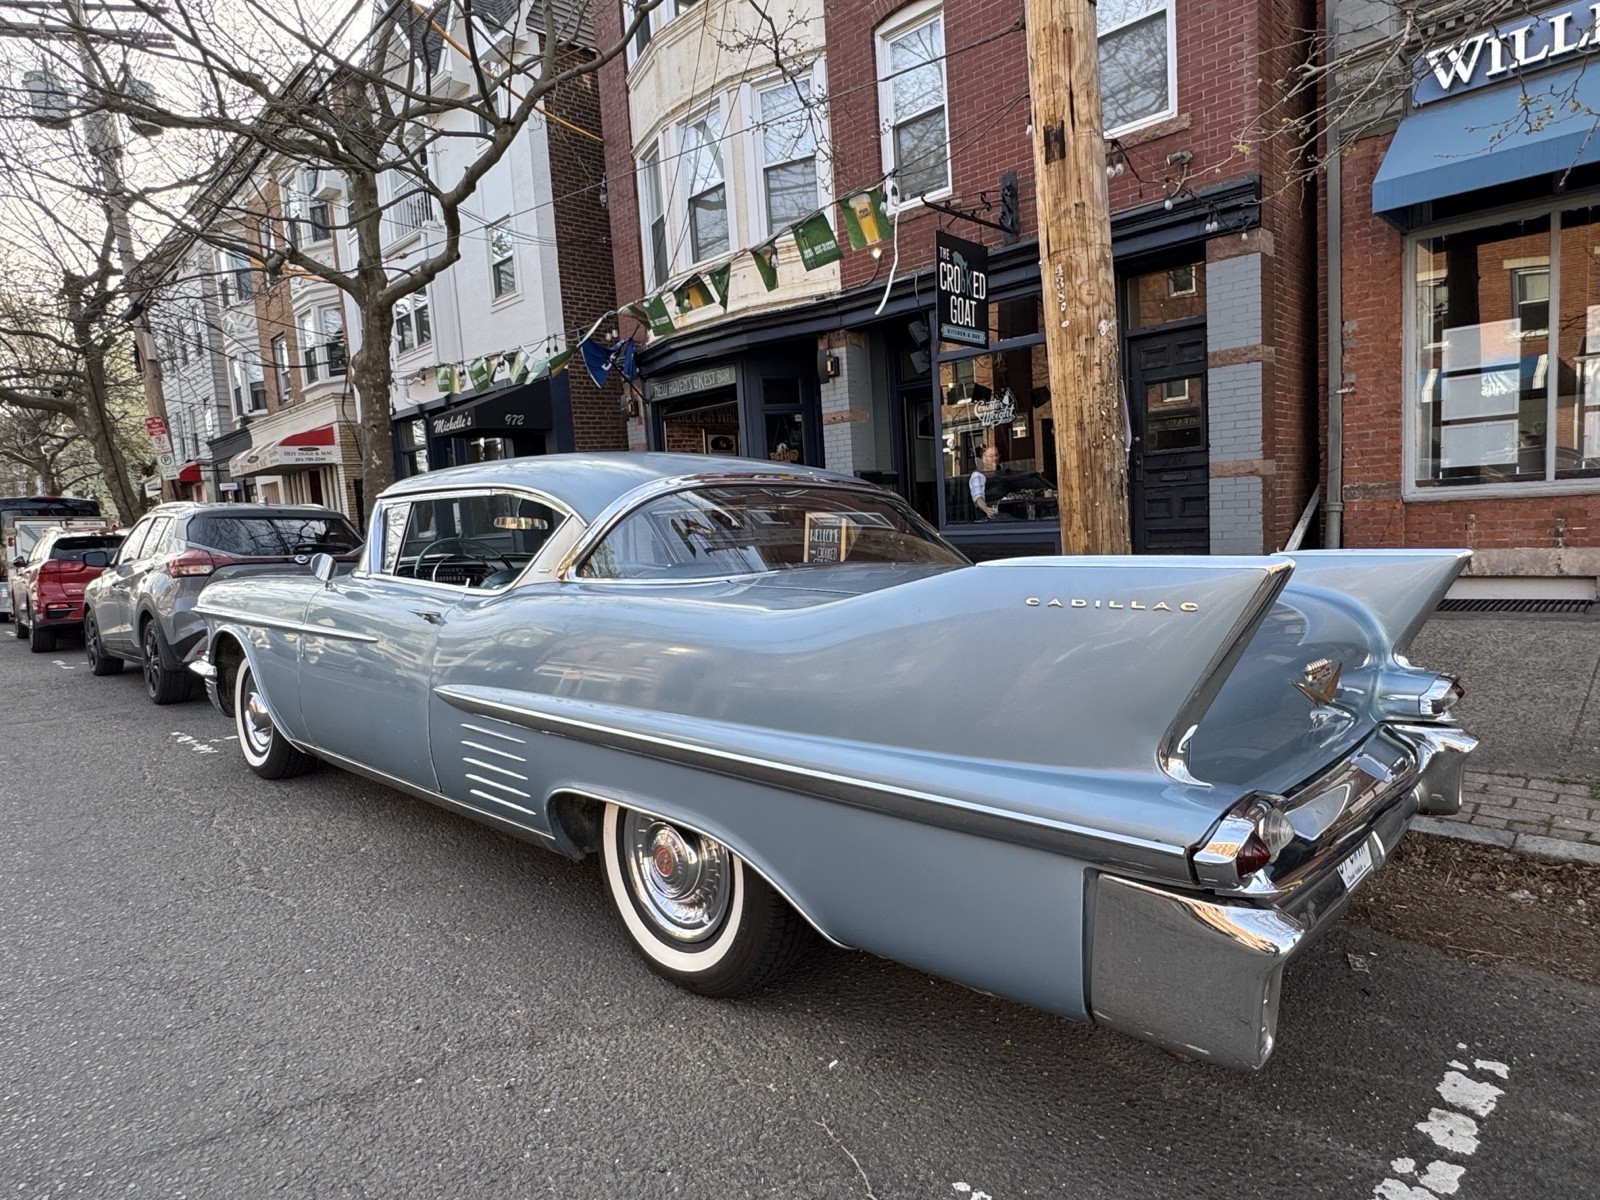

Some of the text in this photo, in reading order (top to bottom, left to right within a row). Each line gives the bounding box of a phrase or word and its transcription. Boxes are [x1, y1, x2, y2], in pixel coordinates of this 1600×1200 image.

[939, 246, 950, 260] THE
[939, 262, 986, 300] CROOKED
[950, 295, 977, 328] GOAT
[654, 383, 668, 398] NEW
[717, 368, 731, 384] BAR
[505, 414, 525, 426] 972
[974, 399, 1003, 418] Counter
[982, 404, 1016, 427] Weight
[433, 411, 472, 434] Michelle's
[1025, 597, 1199, 612] CADILLAC
